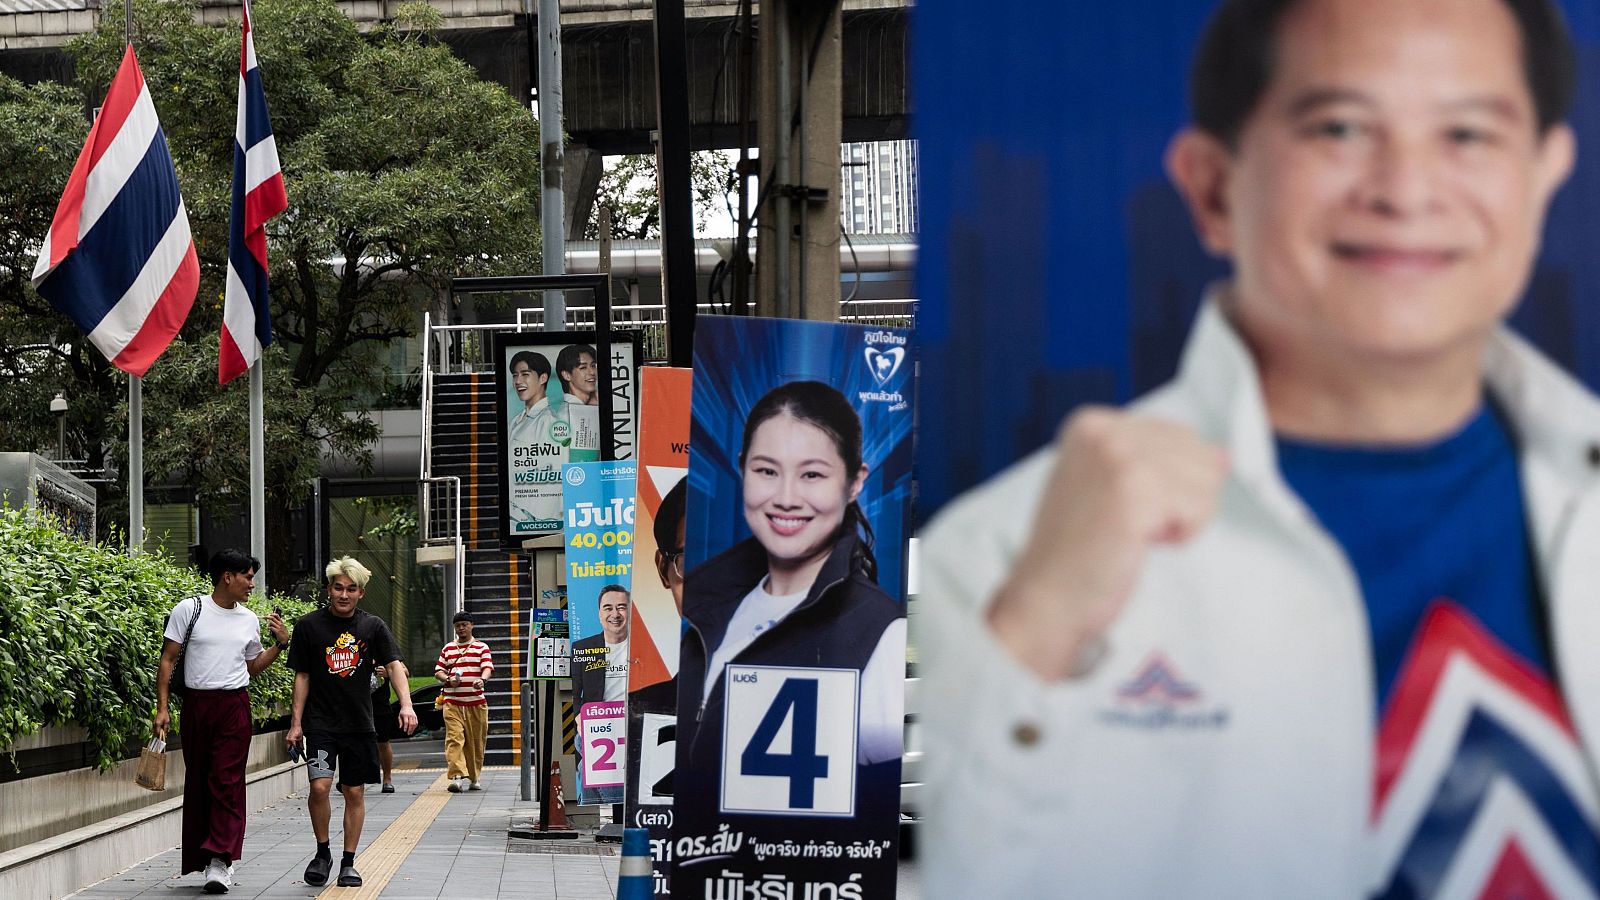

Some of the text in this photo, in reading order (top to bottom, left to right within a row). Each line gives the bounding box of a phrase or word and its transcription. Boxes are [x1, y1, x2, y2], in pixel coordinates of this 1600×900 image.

[864, 331, 906, 345] ภูมิใจไทย
[859, 390, 902, 403] พูดแล้วทำ
[513, 443, 560, 457] ยาสีฟัน
[514, 457, 538, 467] ระดับ
[522, 522, 558, 530] watsons
[570, 530, 633, 549] 40,00
[331, 652, 354, 661] HUMAN
[733, 671, 758, 683] เบอร์
[590, 723, 612, 733] เบอร์
[740, 678, 829, 809] 4
[635, 809, 674, 829] (เสก)
[676, 823, 743, 857] ดร.ส้ม
[803, 840, 843, 858] ทำจริง
